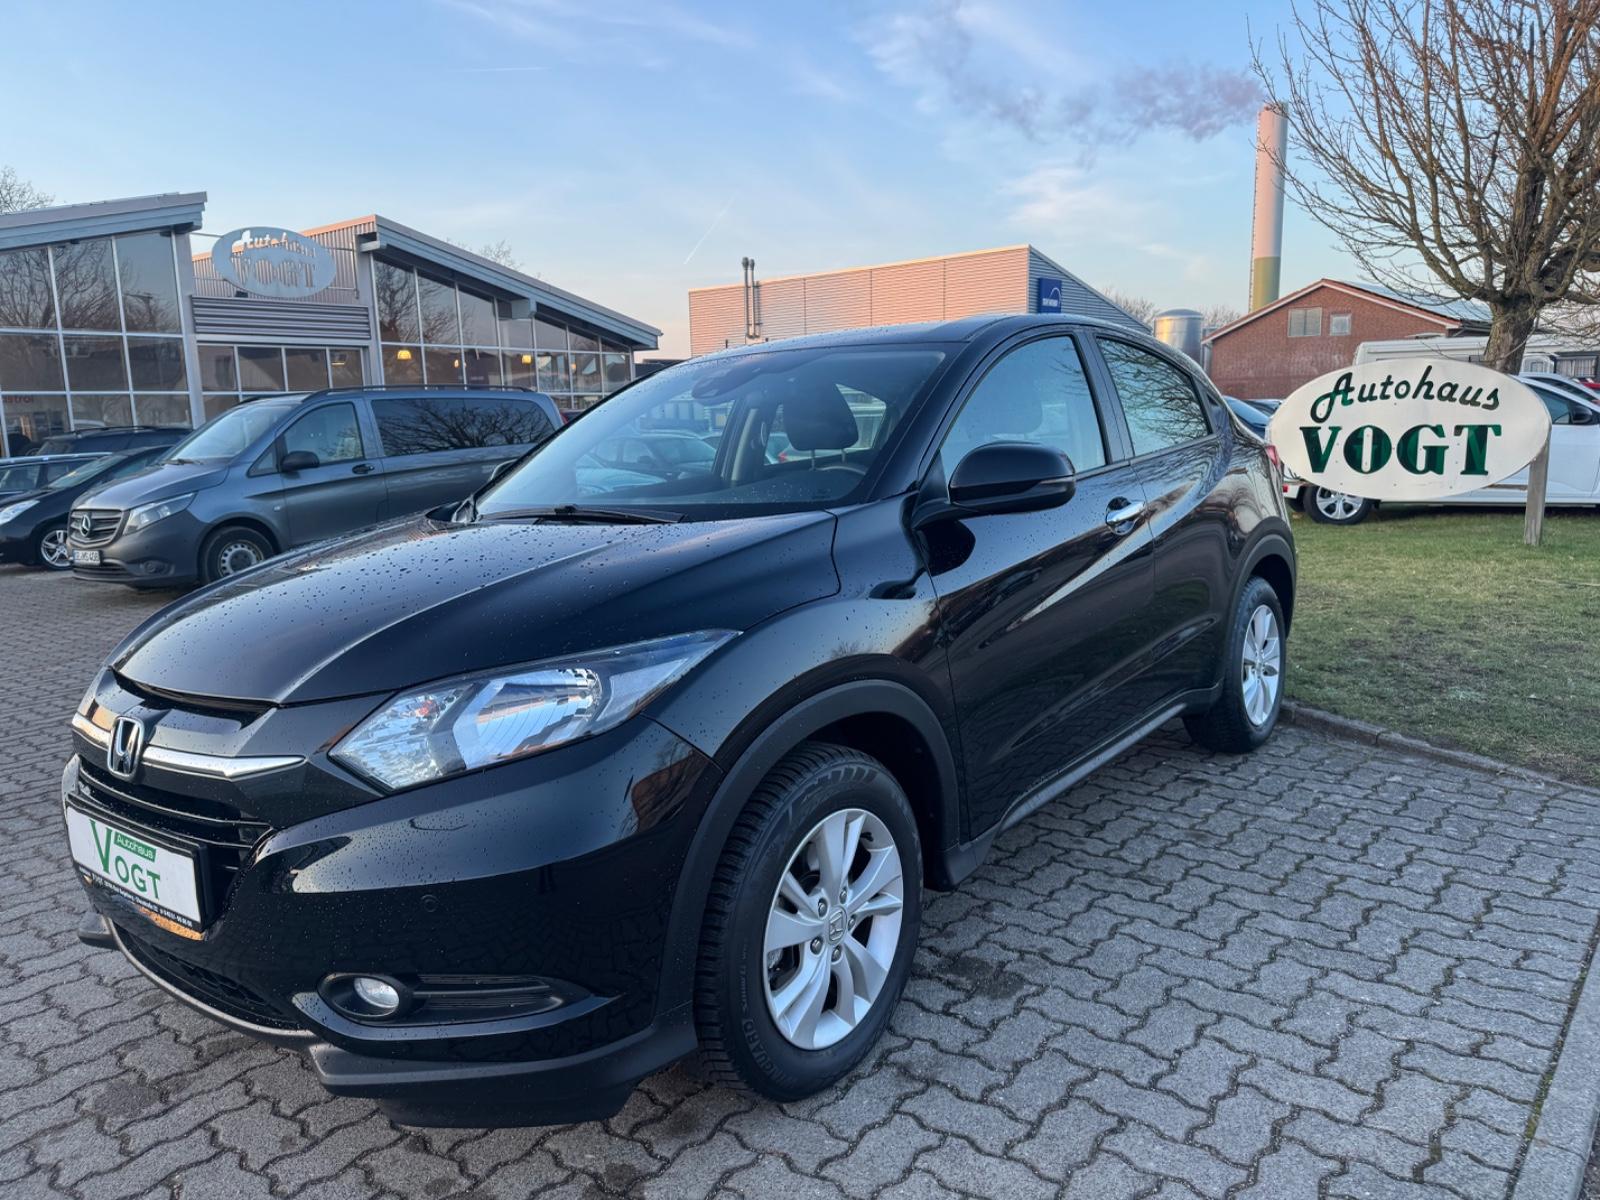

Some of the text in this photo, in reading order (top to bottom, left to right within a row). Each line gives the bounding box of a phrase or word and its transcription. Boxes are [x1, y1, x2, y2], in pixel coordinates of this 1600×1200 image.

[229, 257, 316, 288] VOGT
[1310, 365, 1500, 423] Autohaus
[1300, 424, 1502, 475] VOGT
[89, 819, 160, 899] VOGT
[117, 834, 154, 859] Autohaus
